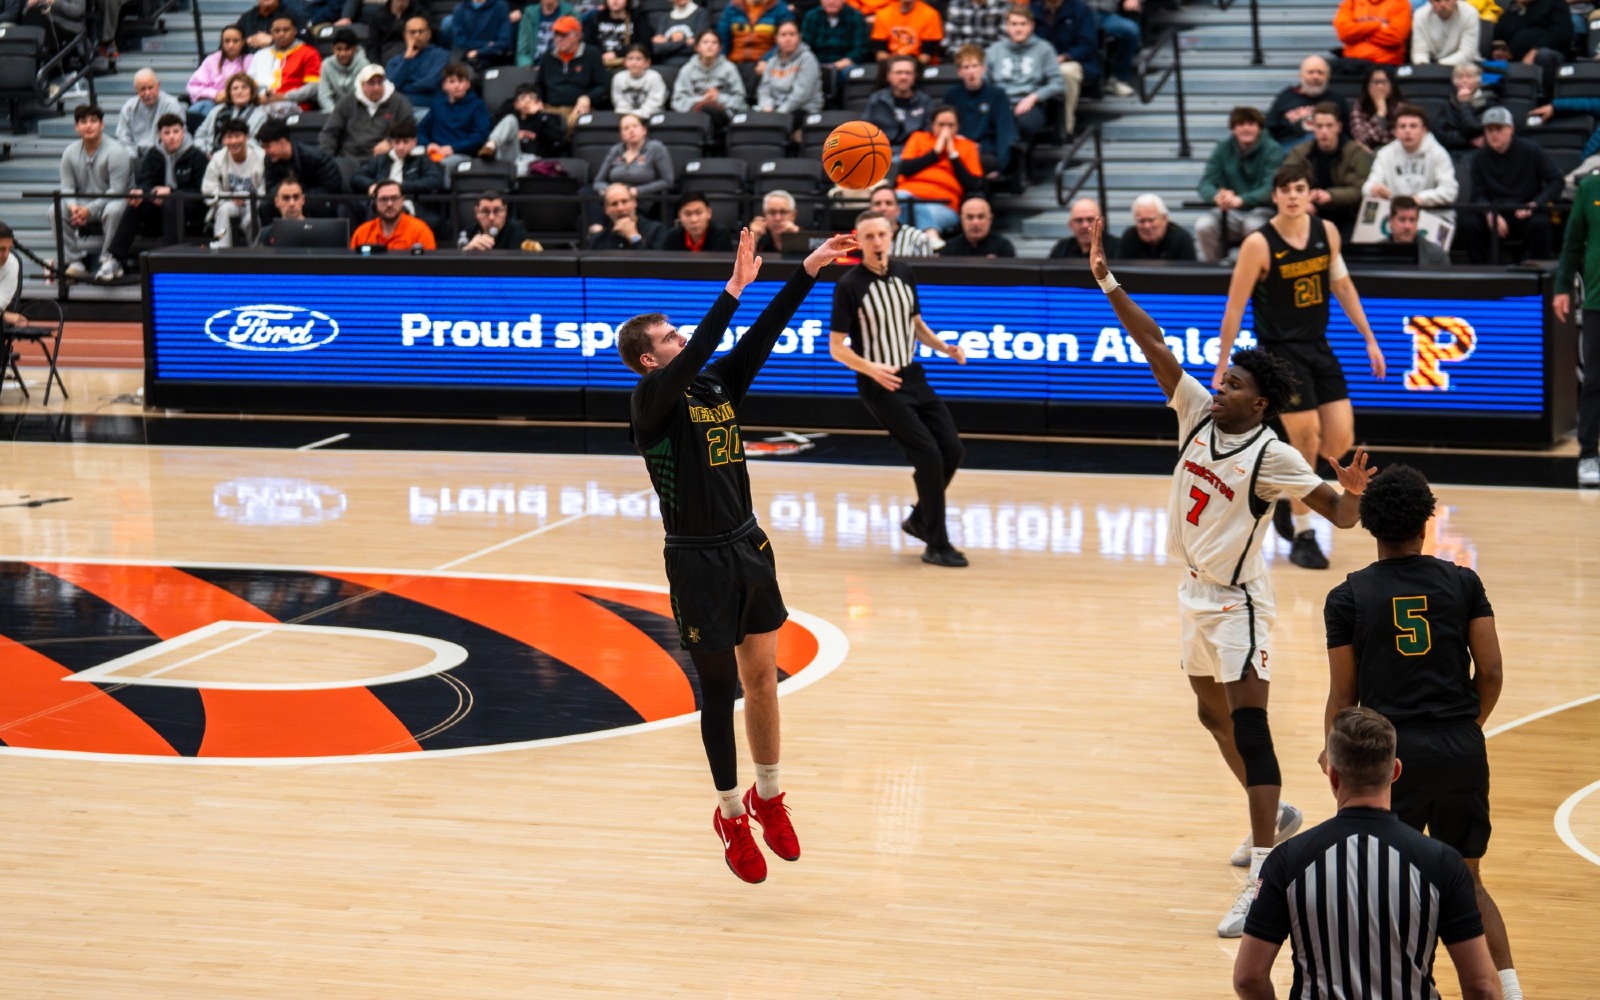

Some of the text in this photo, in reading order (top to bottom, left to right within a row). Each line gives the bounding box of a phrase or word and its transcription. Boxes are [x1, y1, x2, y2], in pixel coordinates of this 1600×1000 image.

[1294, 274, 1323, 308] 21
[228, 311, 315, 344] Ford
[401, 313, 542, 348] Proud
[771, 319, 823, 354] of
[1091, 327, 1258, 365] Athlet
[1403, 315, 1478, 391] P
[706, 425, 744, 467] 20
[1183, 459, 1236, 502] PRINCETON
[1186, 484, 1211, 527] 7
[1393, 595, 1432, 656] 5
[1259, 650, 1269, 668] P
